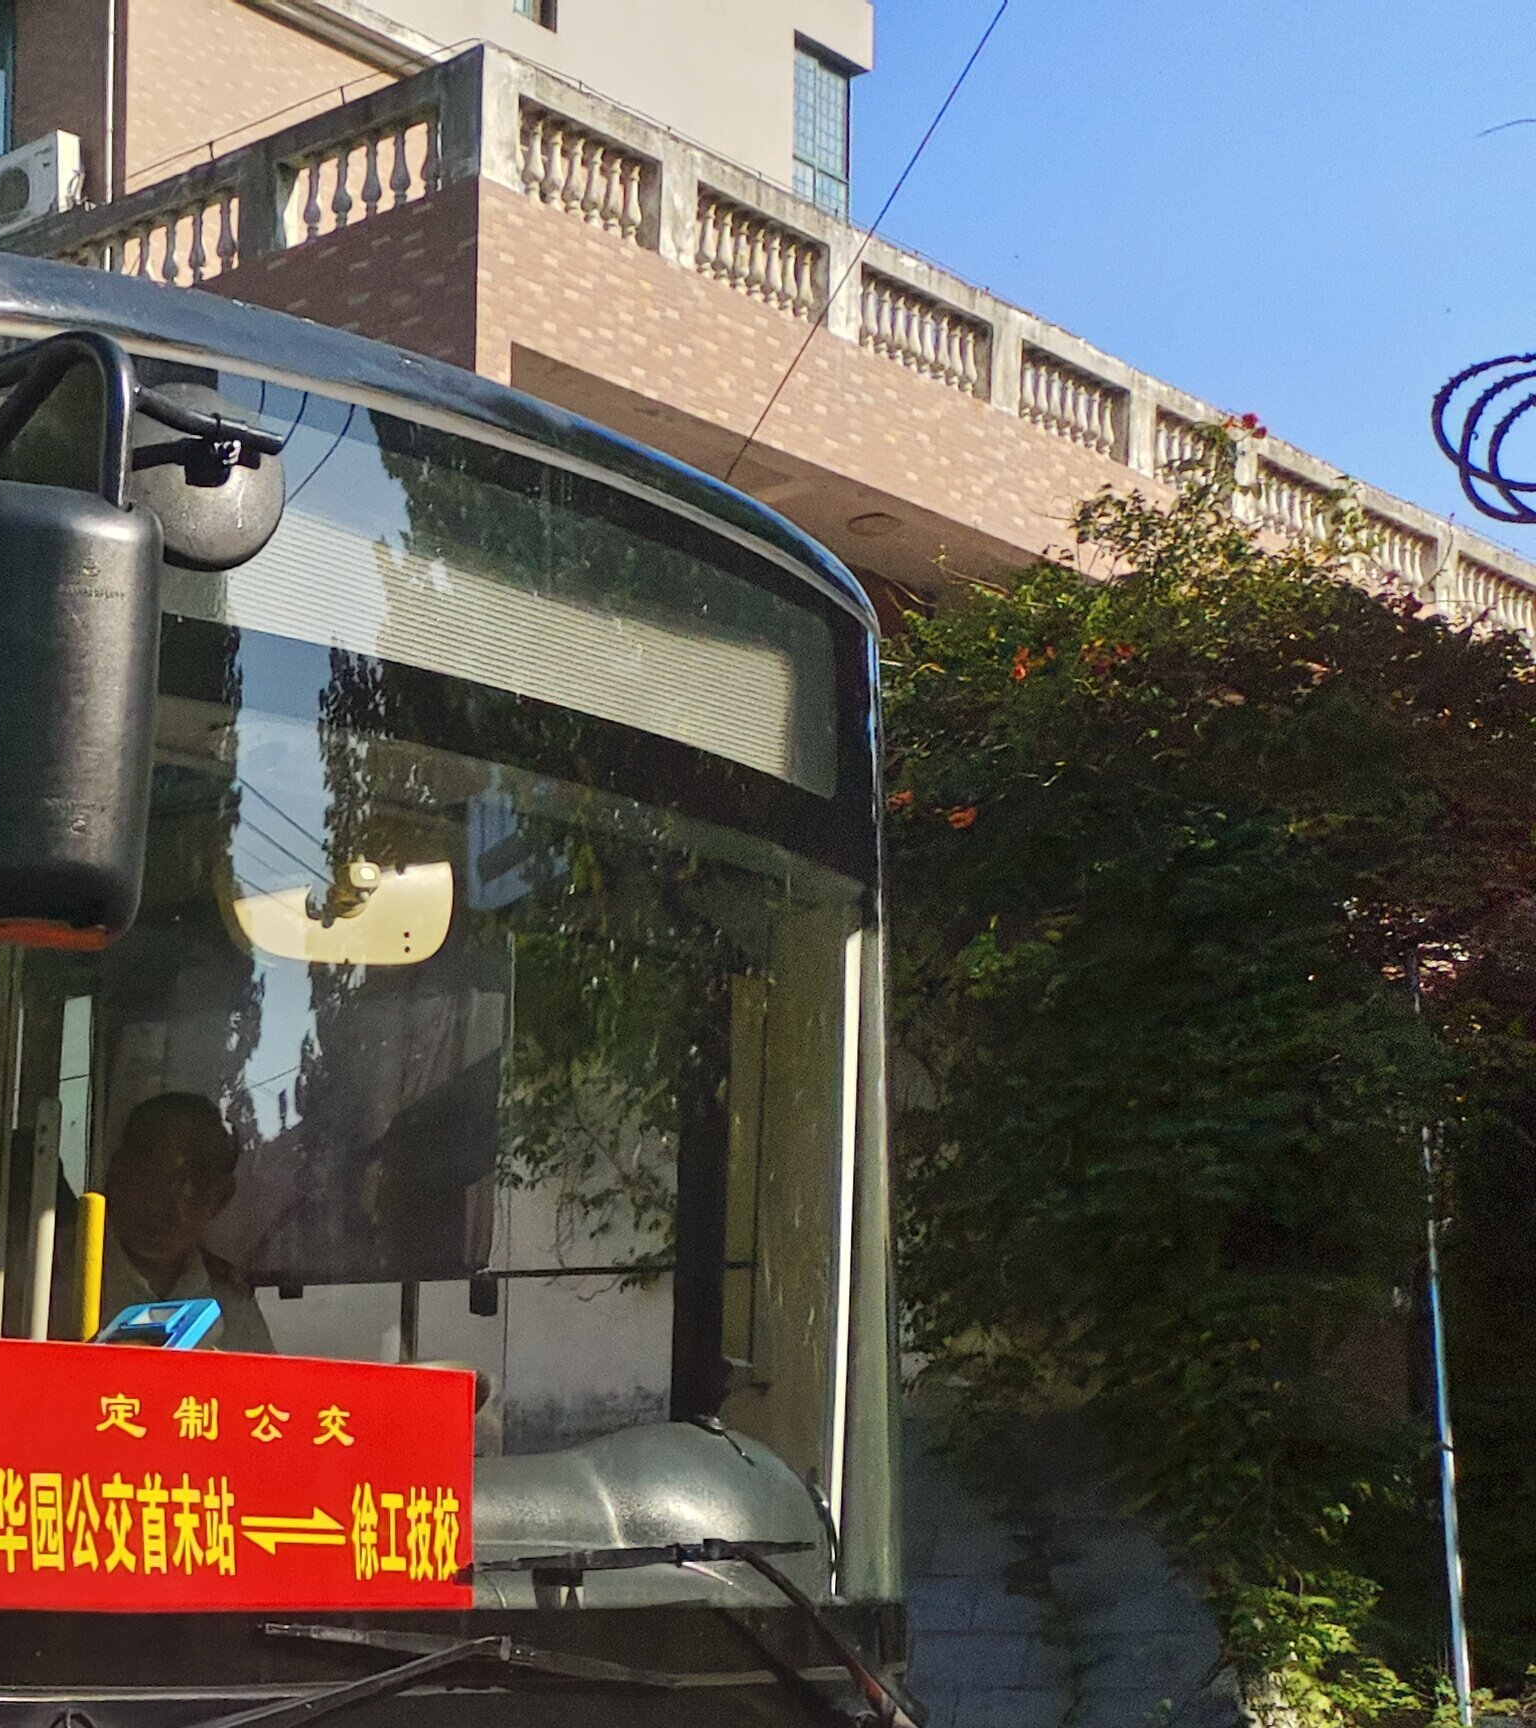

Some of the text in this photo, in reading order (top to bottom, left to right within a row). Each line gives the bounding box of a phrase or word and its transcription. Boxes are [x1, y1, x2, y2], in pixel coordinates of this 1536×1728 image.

[95, 1392, 356, 1447] 定制公交
[351, 1481, 460, 1581] 徐工技校
